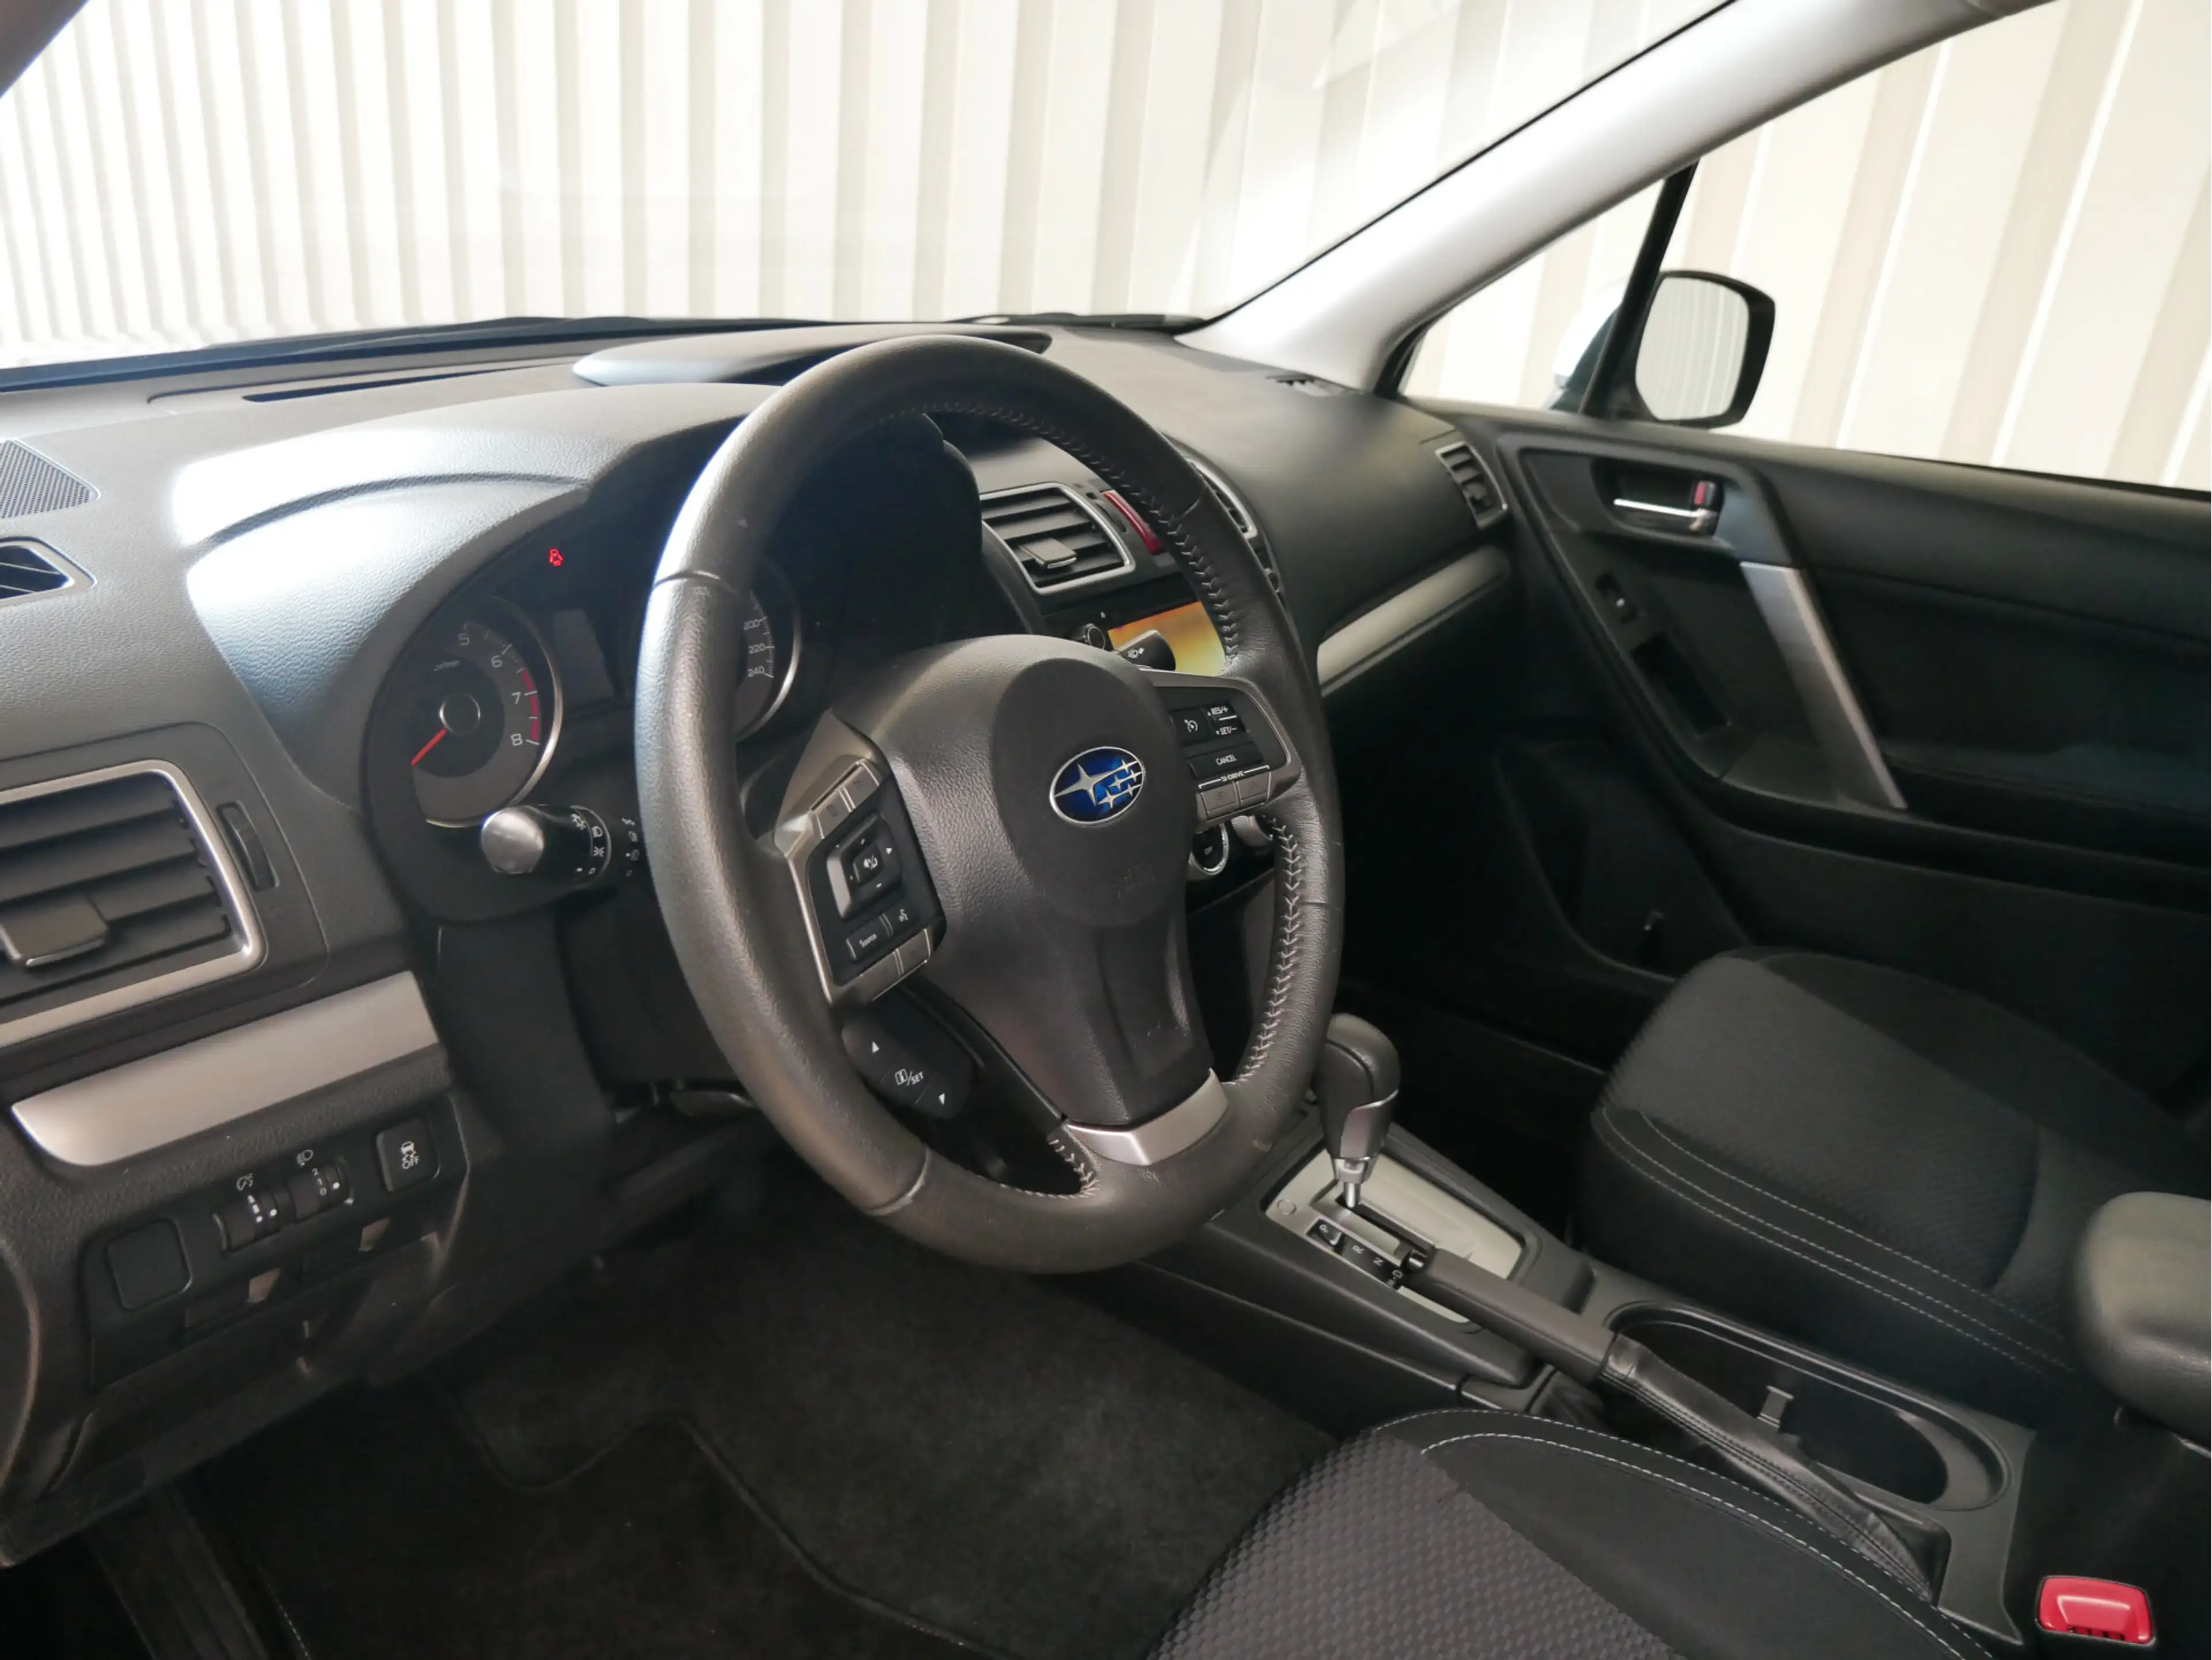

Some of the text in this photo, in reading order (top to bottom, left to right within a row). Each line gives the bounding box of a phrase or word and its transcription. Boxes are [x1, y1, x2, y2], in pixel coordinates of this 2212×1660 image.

[458, 633, 470, 646] 5
[749, 643, 766, 654] 220
[491, 655, 502, 668] 6
[747, 666, 765, 678] 240
[512, 692, 521, 704] 7
[511, 733, 523, 746] 8
[1215, 754, 1237, 765] CANCEL
[402, 1156, 419, 1169] OFF
[312, 1168, 319, 1176] 2
[1319, 1224, 1329, 1233] P
[1352, 1245, 1365, 1254] R
[1373, 1257, 1384, 1266] N
